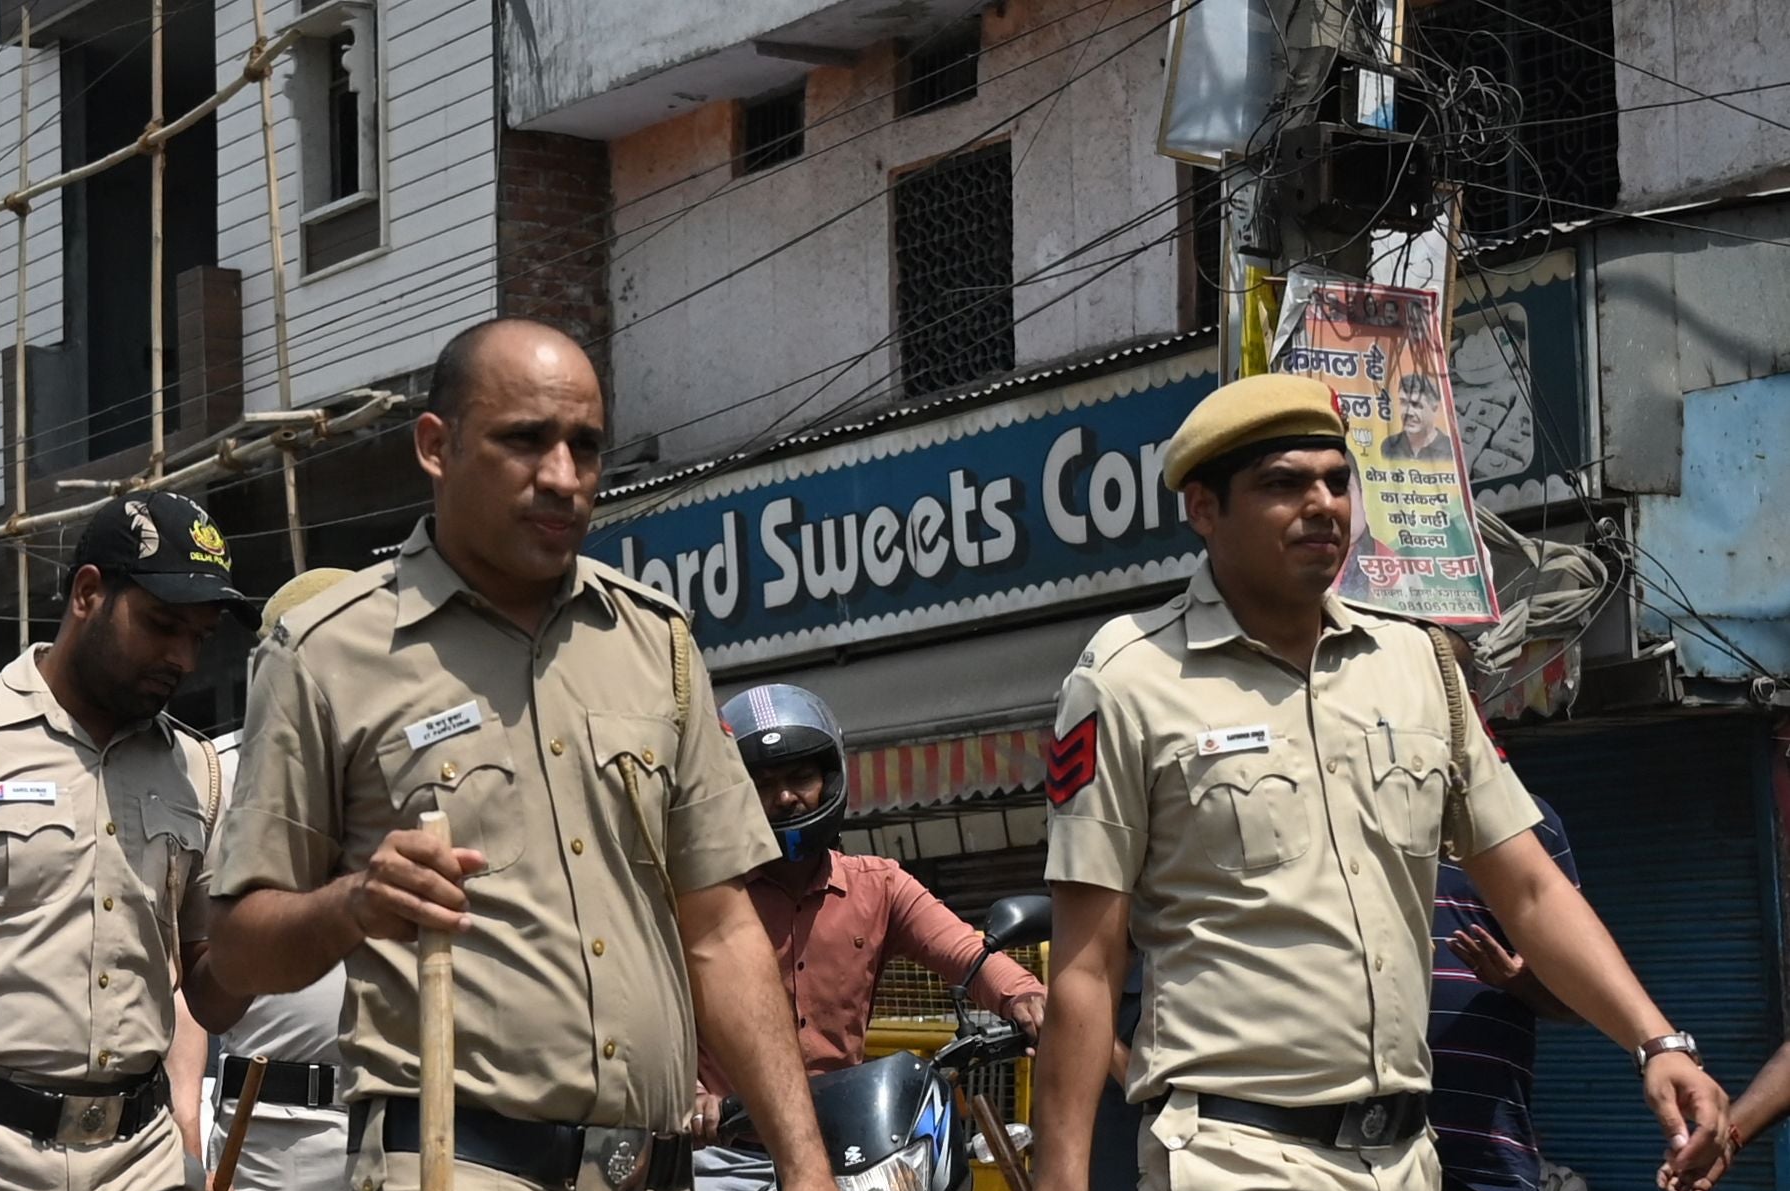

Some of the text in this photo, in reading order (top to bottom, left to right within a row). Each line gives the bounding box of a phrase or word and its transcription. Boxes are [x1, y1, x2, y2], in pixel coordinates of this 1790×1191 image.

[1281, 344, 1384, 381] कमल है
[1376, 389, 1392, 420] है
[1365, 467, 1455, 484] क्षेत्र के विकास
[1380, 490, 1449, 505] का संकल्प
[759, 468, 1018, 610] Sweets
[1043, 427, 1188, 545] Corn
[1388, 510, 1417, 527] कोई
[1398, 530, 1446, 547] विकल्प
[1359, 555, 1478, 584] सुभाष झा
